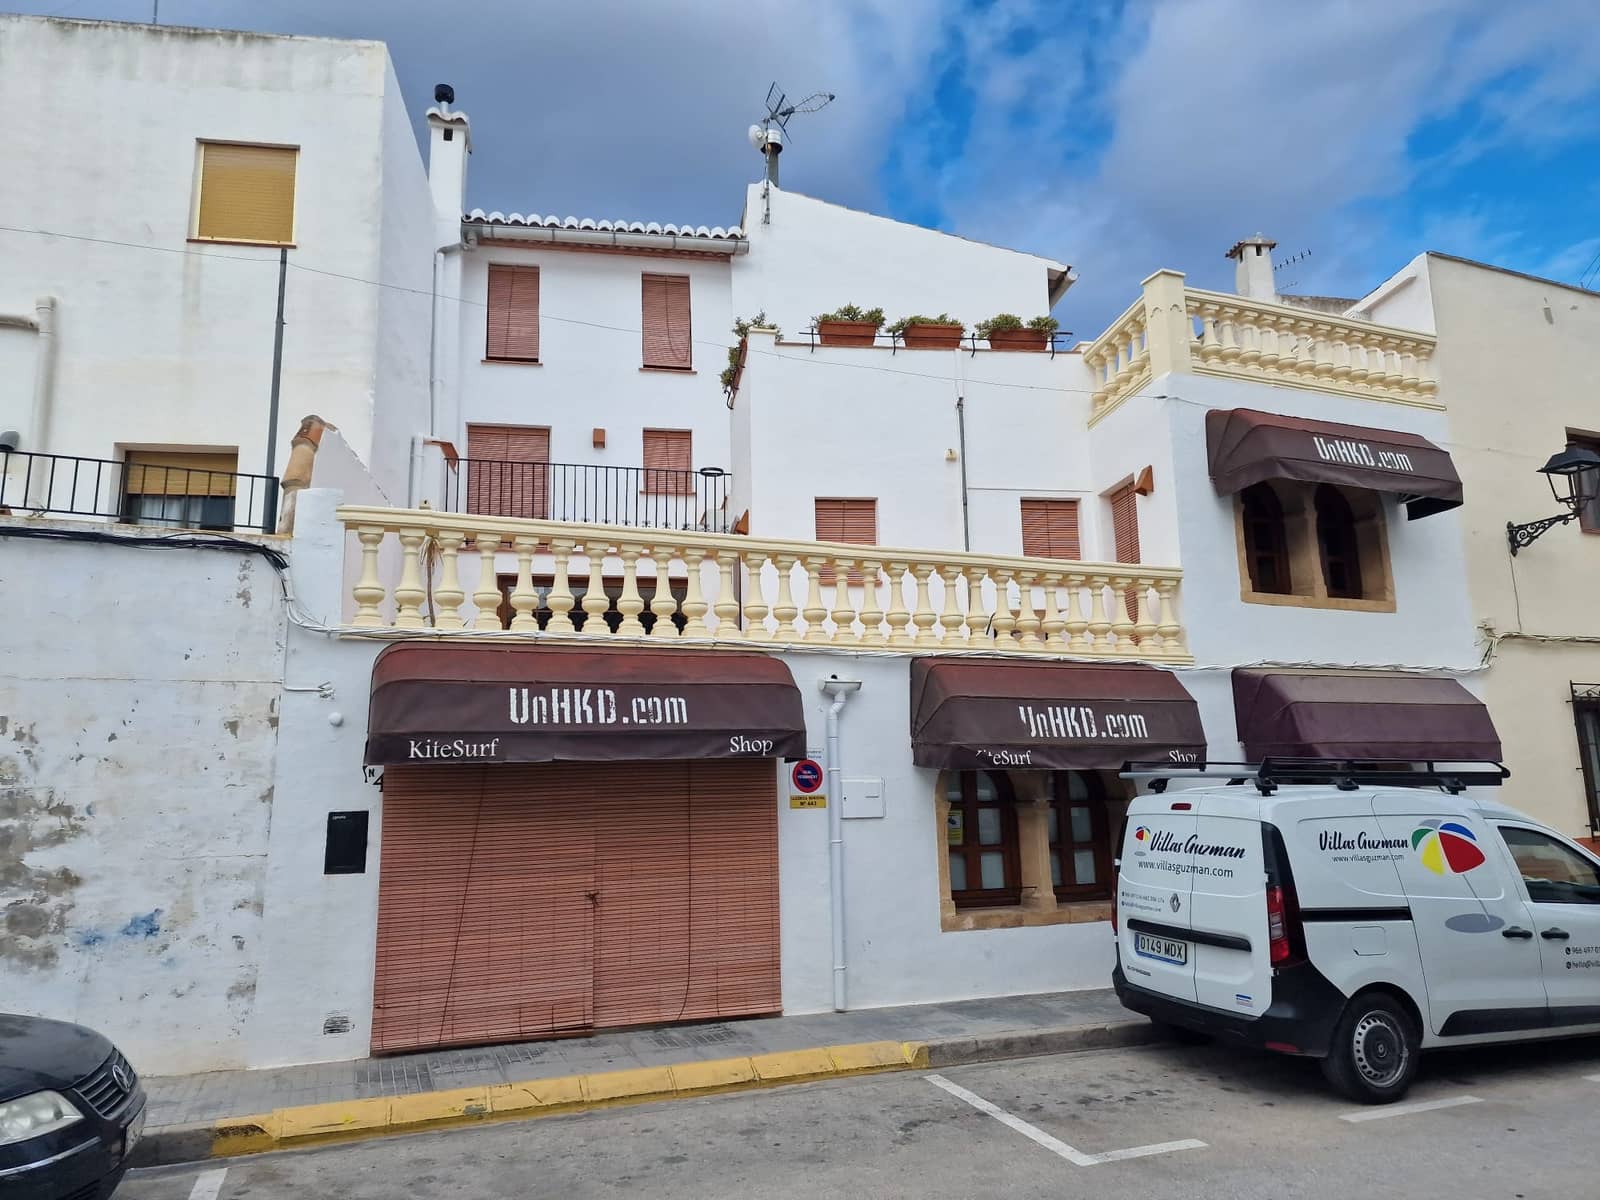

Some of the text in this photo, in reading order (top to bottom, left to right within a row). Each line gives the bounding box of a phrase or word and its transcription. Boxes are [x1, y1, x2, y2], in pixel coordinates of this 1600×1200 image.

[1313, 436, 1414, 472] UnHKD.com
[509, 687, 688, 724] UnHKD.com
[408, 736, 773, 759] KiteSurf Shop
[1150, 830, 1246, 859] Villas Guzman
[1319, 830, 1408, 851] Villas Guzman
[1138, 860, 1233, 878] www.villasguzman.com
[1140, 936, 1183, 959] 0149 MDX
